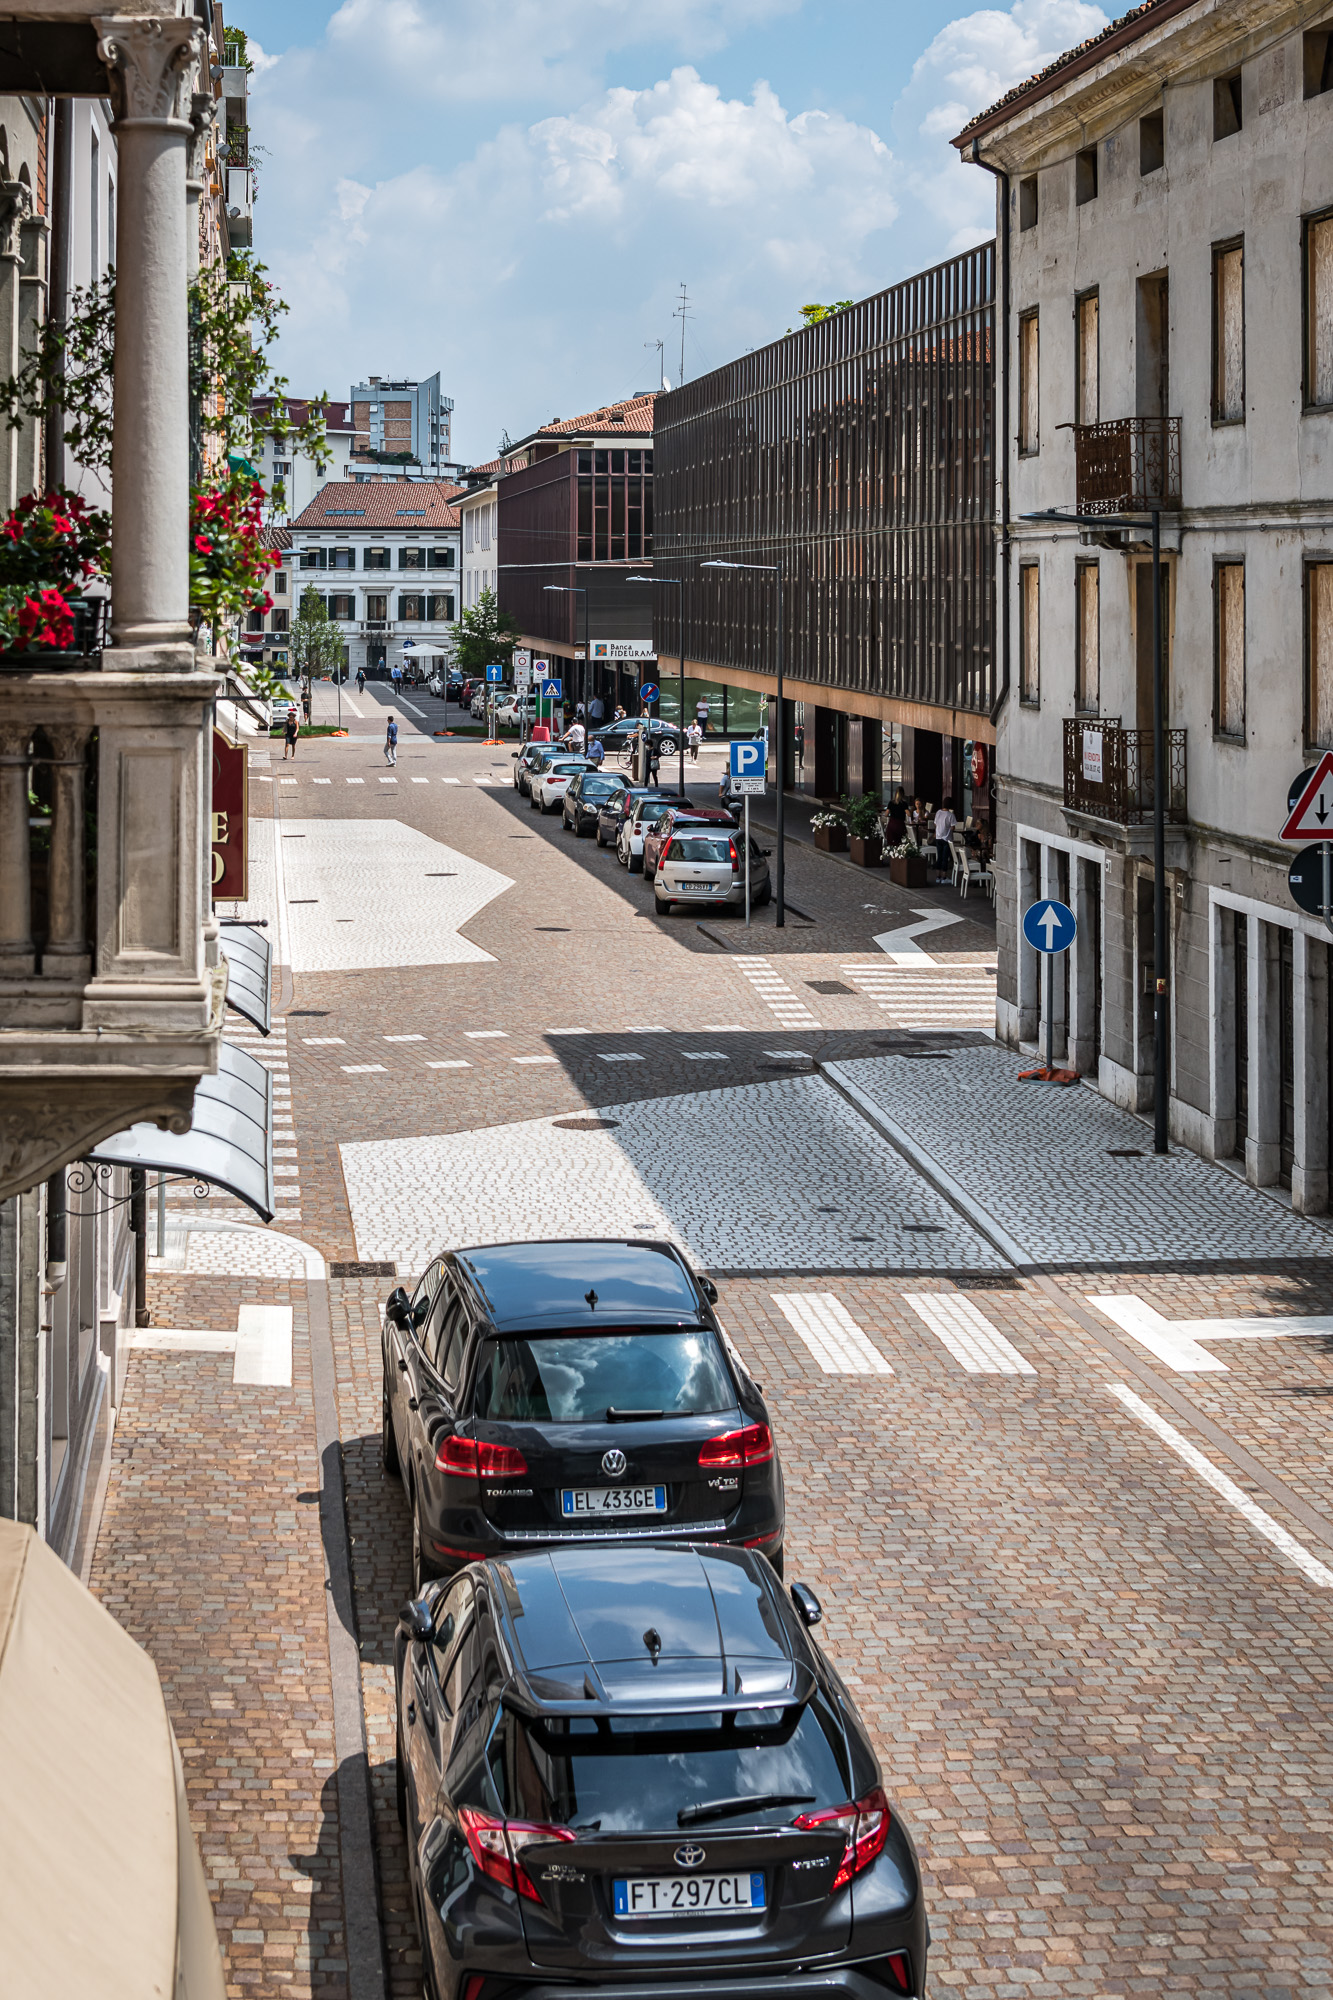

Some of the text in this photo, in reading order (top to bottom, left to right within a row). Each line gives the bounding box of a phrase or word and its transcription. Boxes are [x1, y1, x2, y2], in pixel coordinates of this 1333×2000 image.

[737, 745, 758, 773] P
[575, 1489, 654, 1510] EL 433GE
[631, 1878, 748, 1910] FT 297CL
